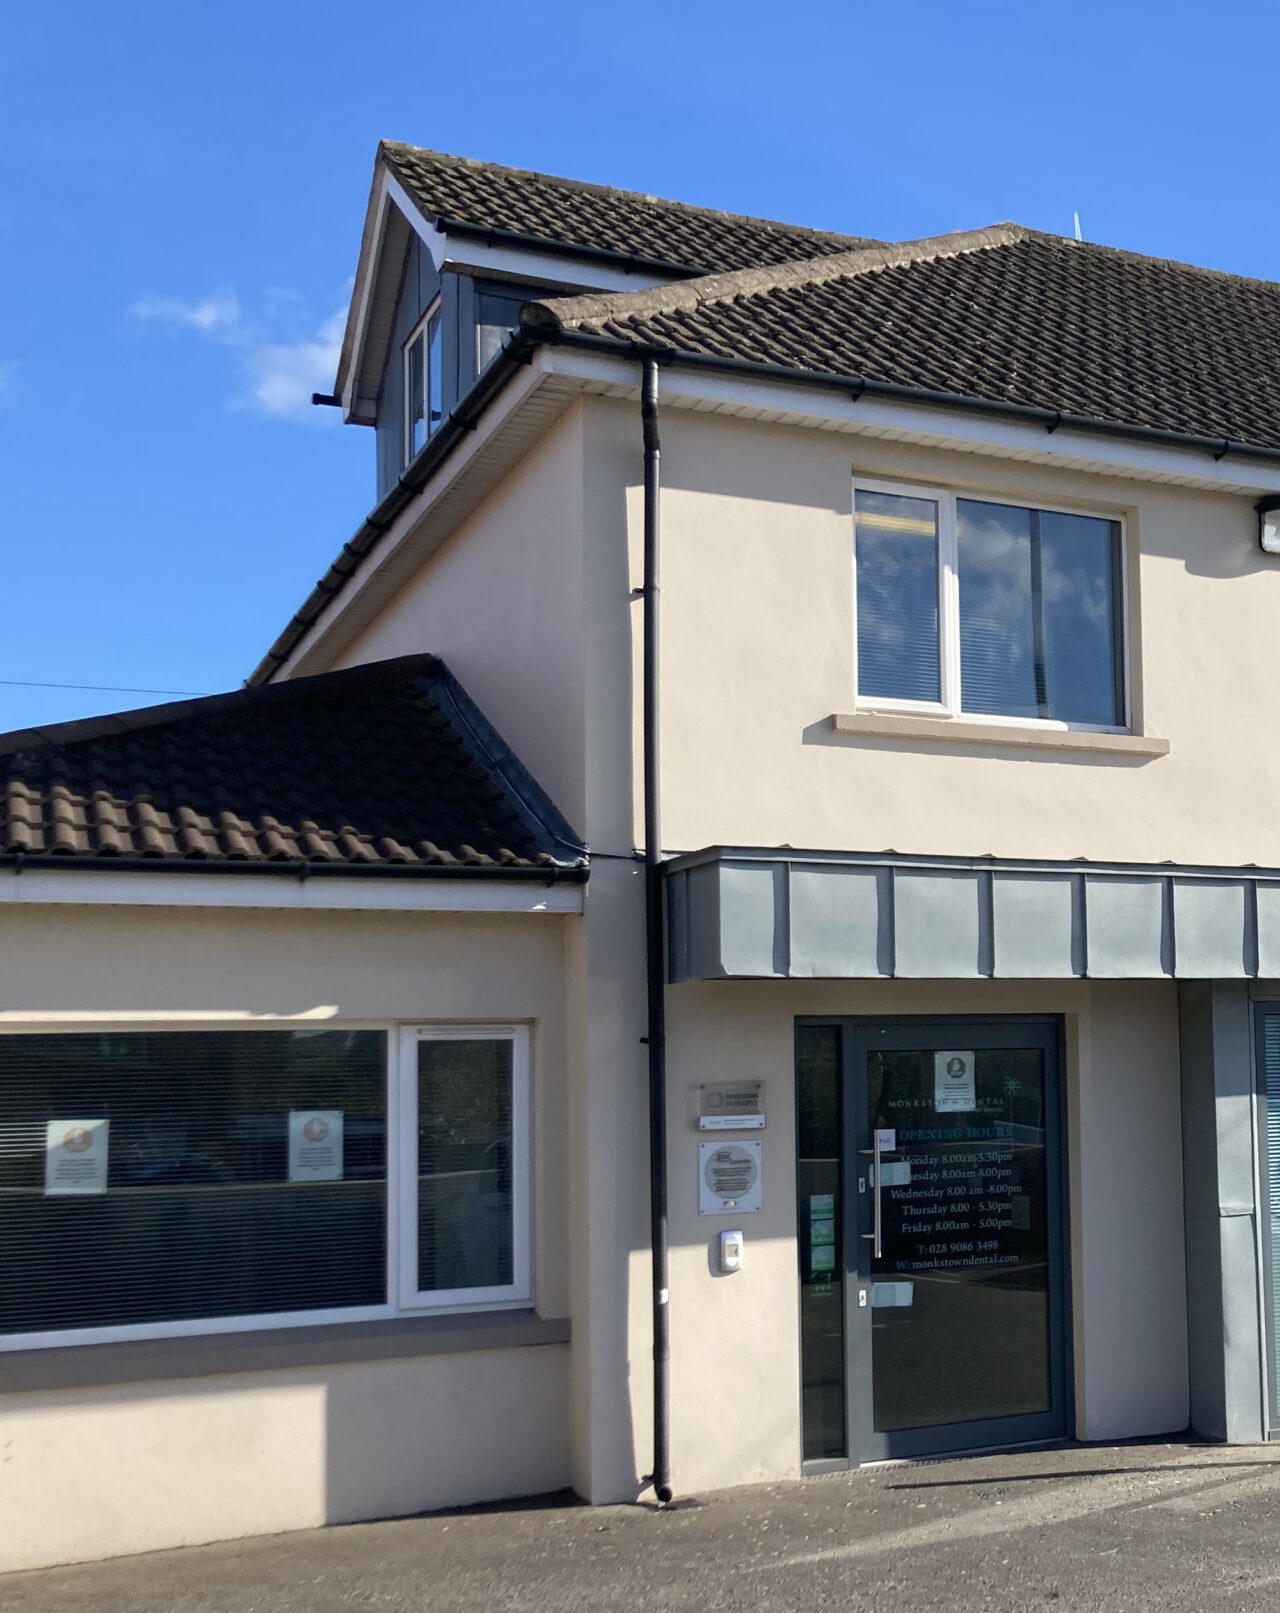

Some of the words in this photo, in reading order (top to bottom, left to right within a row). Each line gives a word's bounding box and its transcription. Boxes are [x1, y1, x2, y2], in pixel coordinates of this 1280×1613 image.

[899, 1128, 962, 1141] OPENING
[967, 1127, 1013, 1138] HOURS
[901, 1154, 939, 1167] Monday
[942, 1152, 1013, 1164] 8.00am-5.30pm
[942, 1168, 1012, 1179] 8.00am-8.00pm
[891, 1186, 944, 1199] Wednesday
[947, 1187, 967, 1196] 8.00
[902, 1204, 947, 1216] Thursday
[950, 1202, 969, 1212] 8.00
[979, 1201, 1012, 1213] 5.30pm
[902, 1222, 932, 1235] Friday
[935, 1220, 969, 1231] 8.00am
[979, 1218, 1013, 1229] 5.00pm
[929, 1244, 947, 1254] 028
[950, 1241, 973, 1252] 9086
[977, 1240, 999, 1250] 3498
[912, 1253, 1019, 1269] monkstowndental.com
